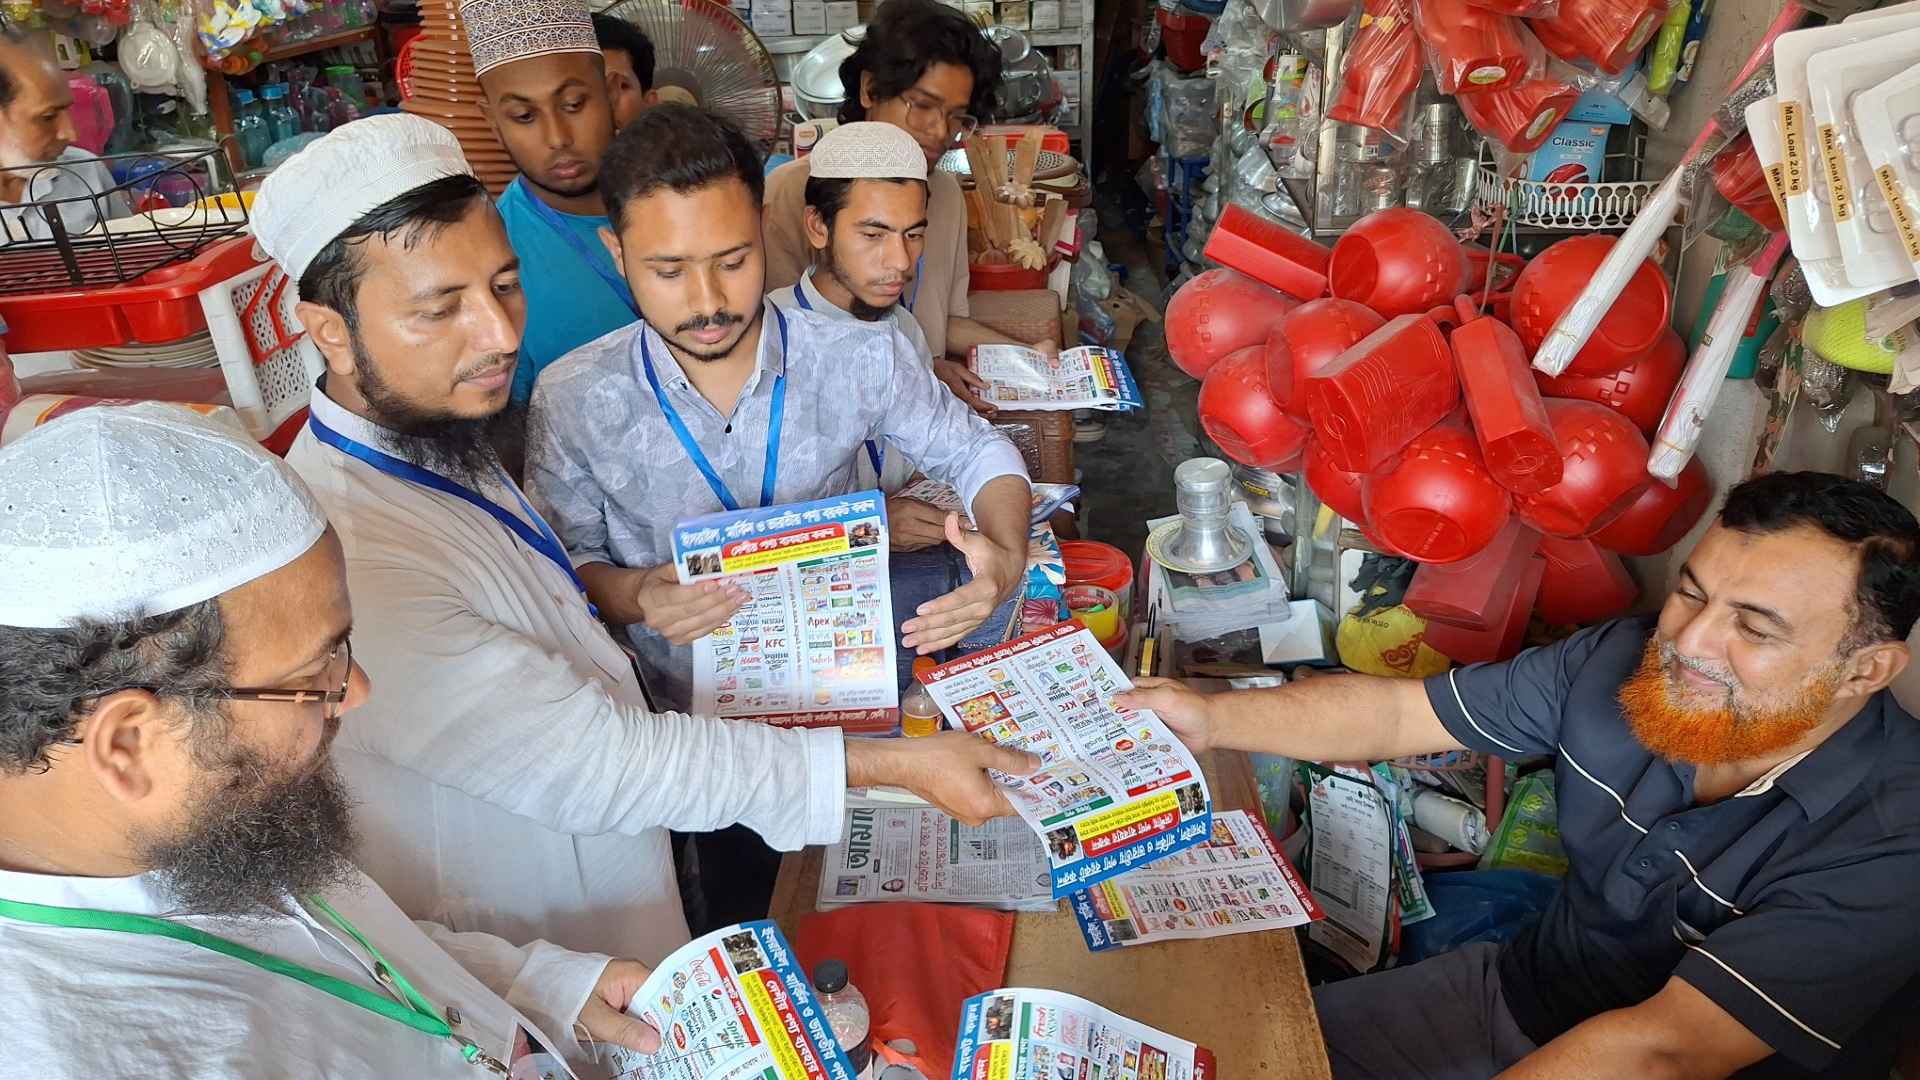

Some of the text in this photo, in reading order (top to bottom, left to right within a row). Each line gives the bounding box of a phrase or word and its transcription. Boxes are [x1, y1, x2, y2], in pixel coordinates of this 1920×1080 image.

[1552, 136, 1595, 147] Classic
[1784, 105, 1800, 191] Max. Load 2.0 kg
[1770, 167, 1784, 192] Max.
[1822, 128, 1847, 217] Max. Load 2.0 kg
[1879, 169, 1895, 195] Max.
[1891, 196, 1908, 224] Load
[808, 616, 830, 632] Apex
[765, 638, 785, 649] KFC
[1057, 700, 1077, 713] KFC
[1030, 729, 1052, 745] Apex
[1137, 822, 1152, 835] পণ্য
[1152, 813, 1173, 830] দেশীয়
[1112, 825, 1137, 842] ব্যবহার
[1155, 831, 1175, 852] মার্কিন
[1119, 842, 1145, 866] ভারতীয়
[1147, 839, 1153, 850] ও
[1103, 854, 1118, 871] পণ্য
[1056, 868, 1077, 888] করুন
[760, 925, 790, 973] ইসরাইল,
[784, 972, 809, 1006] মার্কিন
[801, 1006, 814, 1019] ও
[1034, 1006, 1046, 1037] Fresh
[725, 1018, 748, 1051] Sprite
[765, 979, 790, 1012] দেশীয়
[782, 1012, 801, 1035] পণ্য
[793, 1035, 820, 1074] ব্যবহার
[806, 1019, 837, 1061] ভারতীয়
